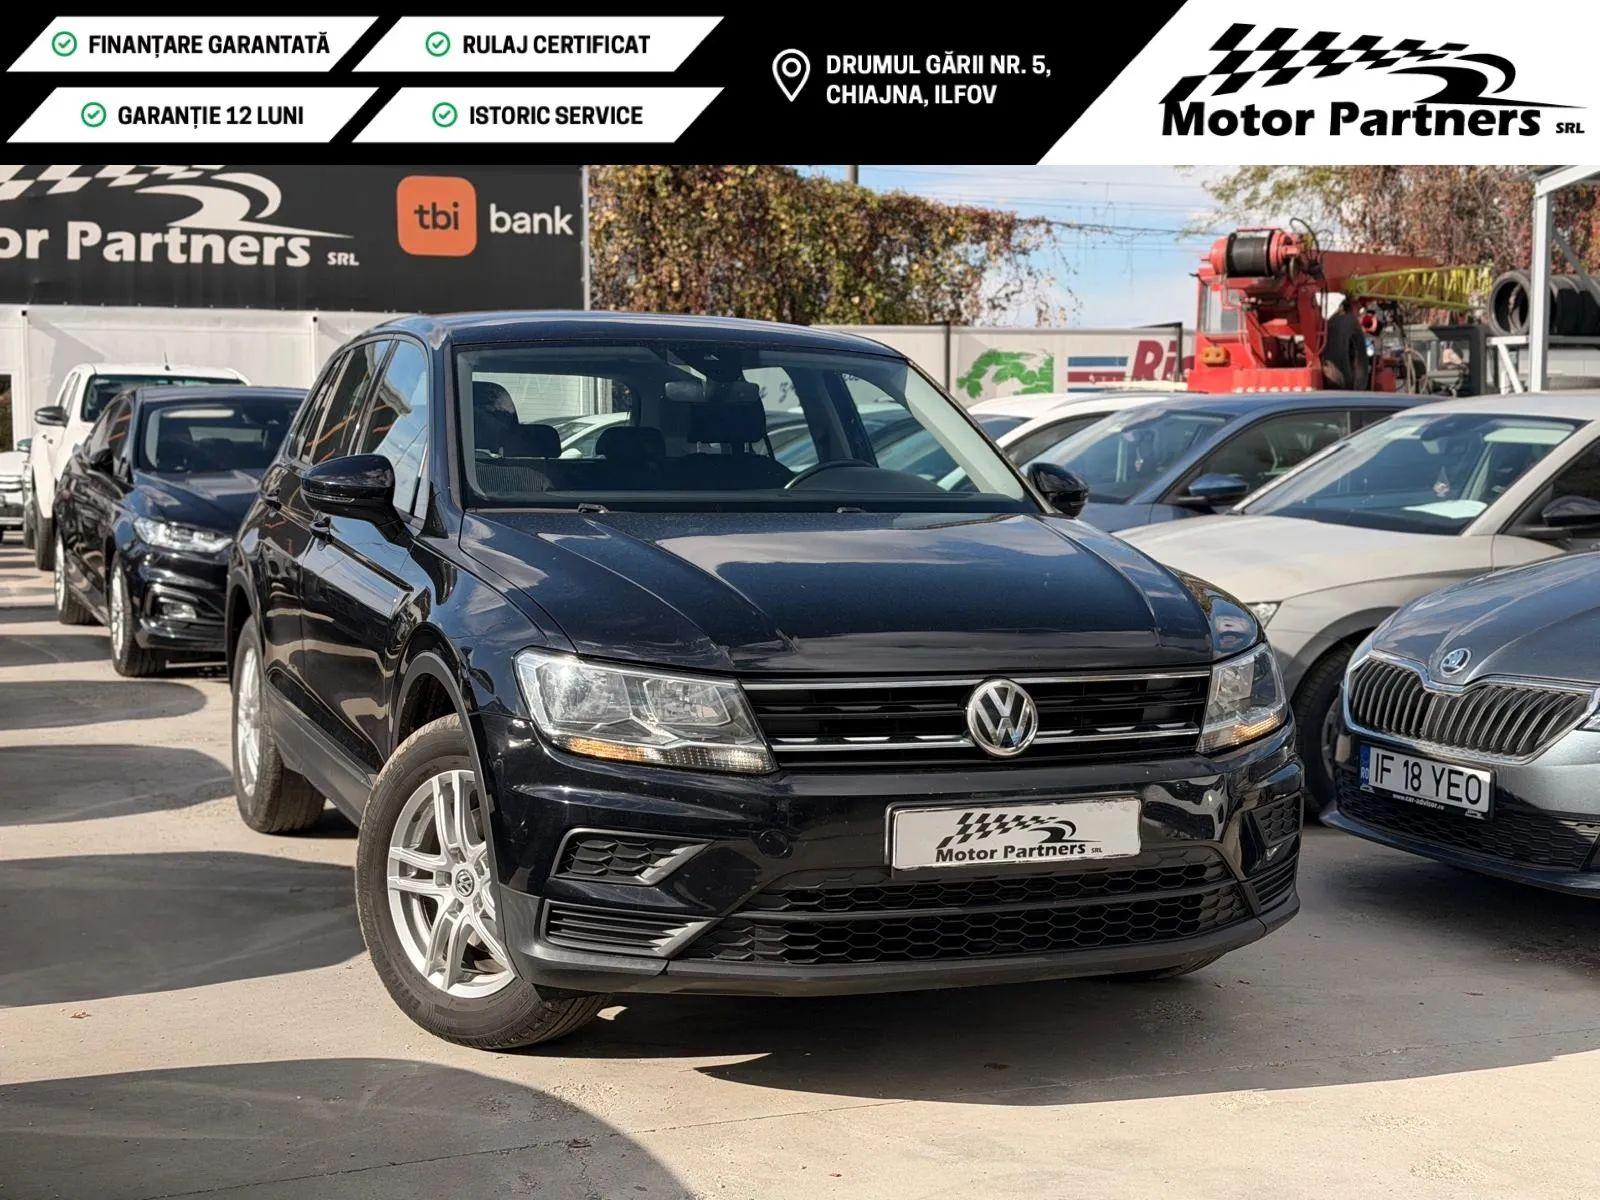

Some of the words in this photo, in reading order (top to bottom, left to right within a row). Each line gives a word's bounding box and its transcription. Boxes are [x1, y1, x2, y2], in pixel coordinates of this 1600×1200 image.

[414, 201, 459, 231] tbi
[489, 203, 574, 236] bank
[66, 220, 311, 267] Partners
[327, 252, 360, 267] SRL
[1374, 752, 1395, 785] IF
[1402, 759, 1423, 792] 18
[1431, 765, 1482, 806] YEO
[935, 847, 998, 863] Motor
[1003, 843, 1086, 859] Partners
